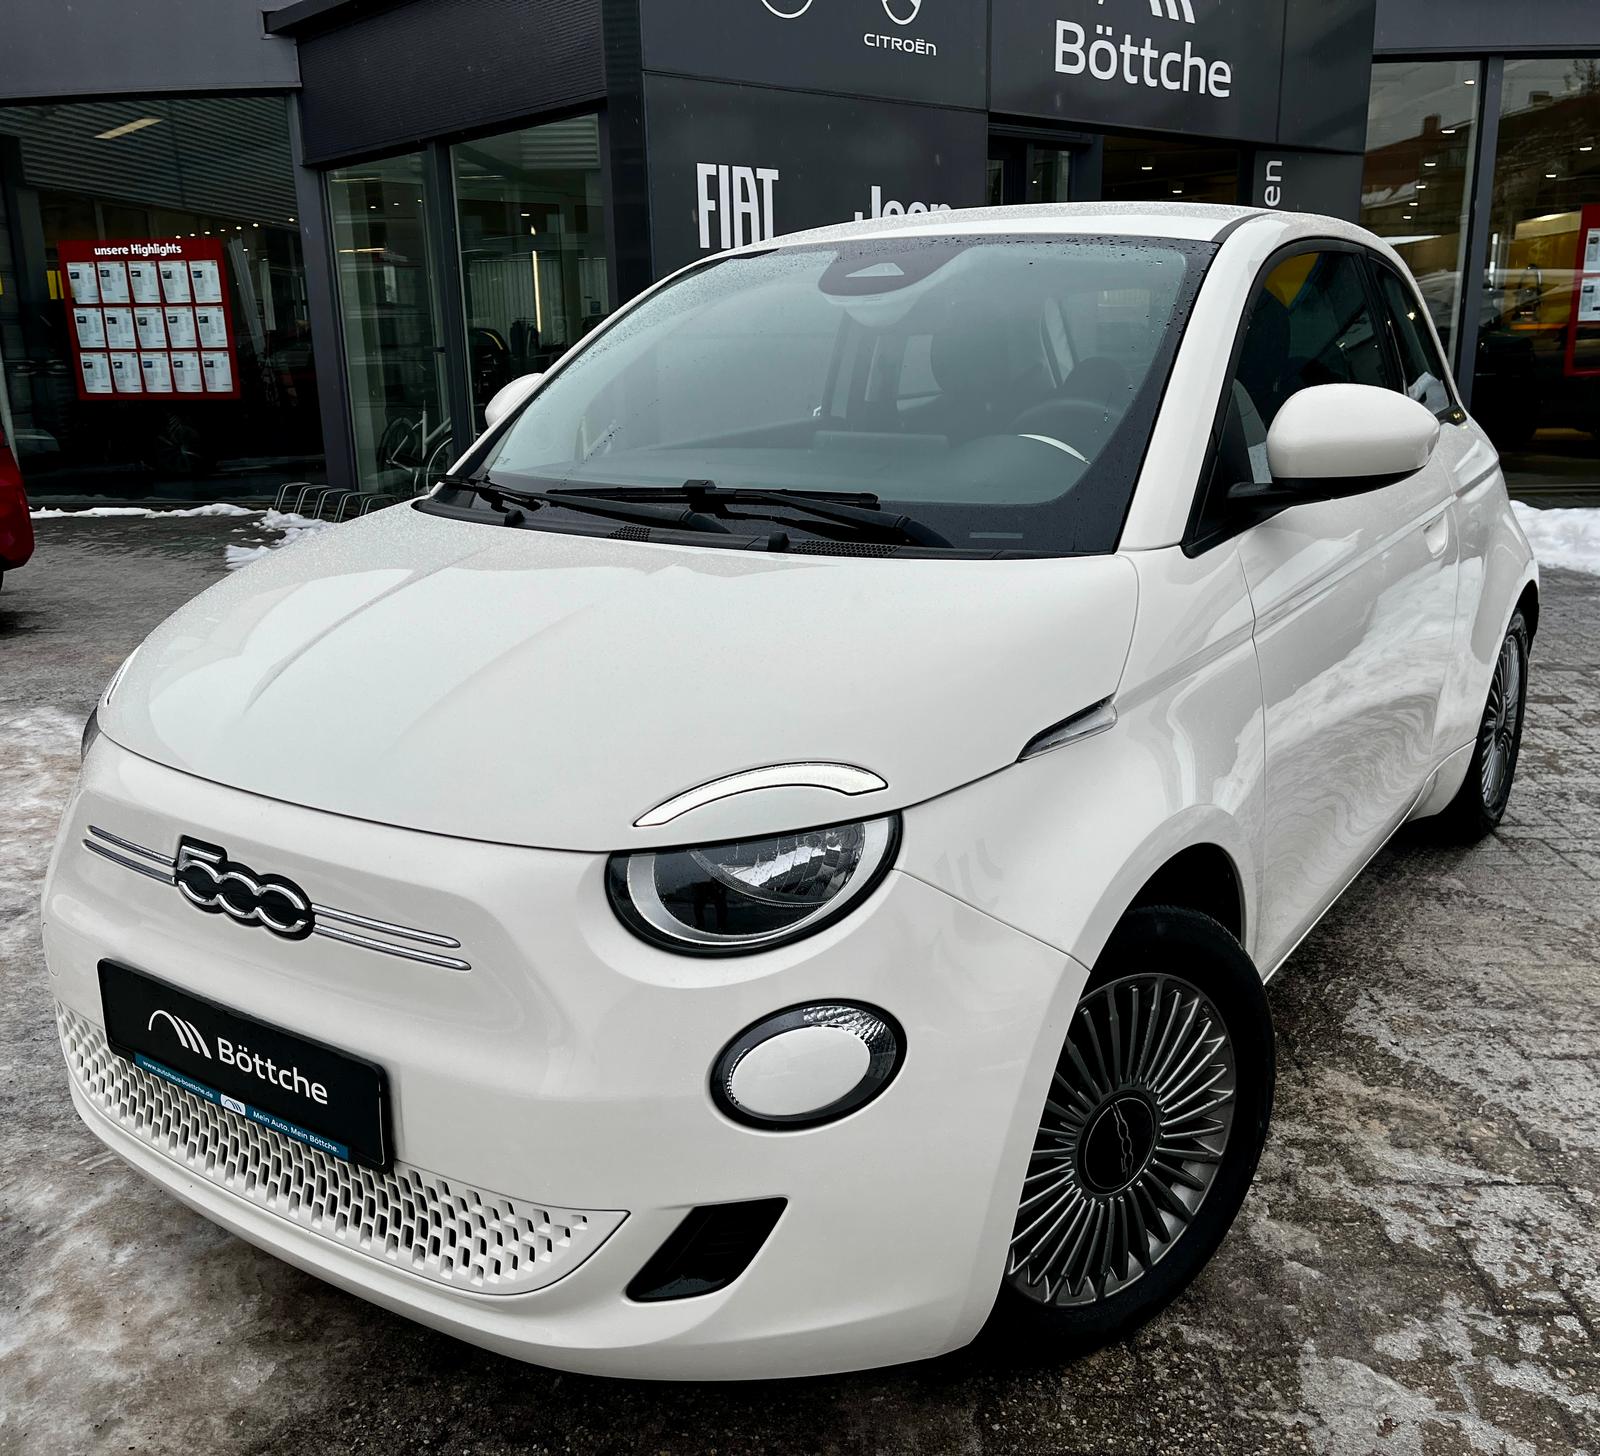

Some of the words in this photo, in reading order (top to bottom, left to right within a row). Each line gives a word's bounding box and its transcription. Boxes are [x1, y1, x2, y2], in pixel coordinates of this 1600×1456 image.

[1055, 19, 1232, 97] Böttche
[696, 162, 779, 249] FIAT
[94, 246, 129, 256] unsere
[130, 242, 182, 257] Highlights
[176, 839, 311, 937] 500
[142, 1060, 214, 1099] www.autohaus-boettche.de
[217, 1037, 328, 1105] Böttche
[253, 1110, 270, 1123] Mein
[270, 1119, 290, 1132] Auto.
[290, 1126, 308, 1140] Mein
